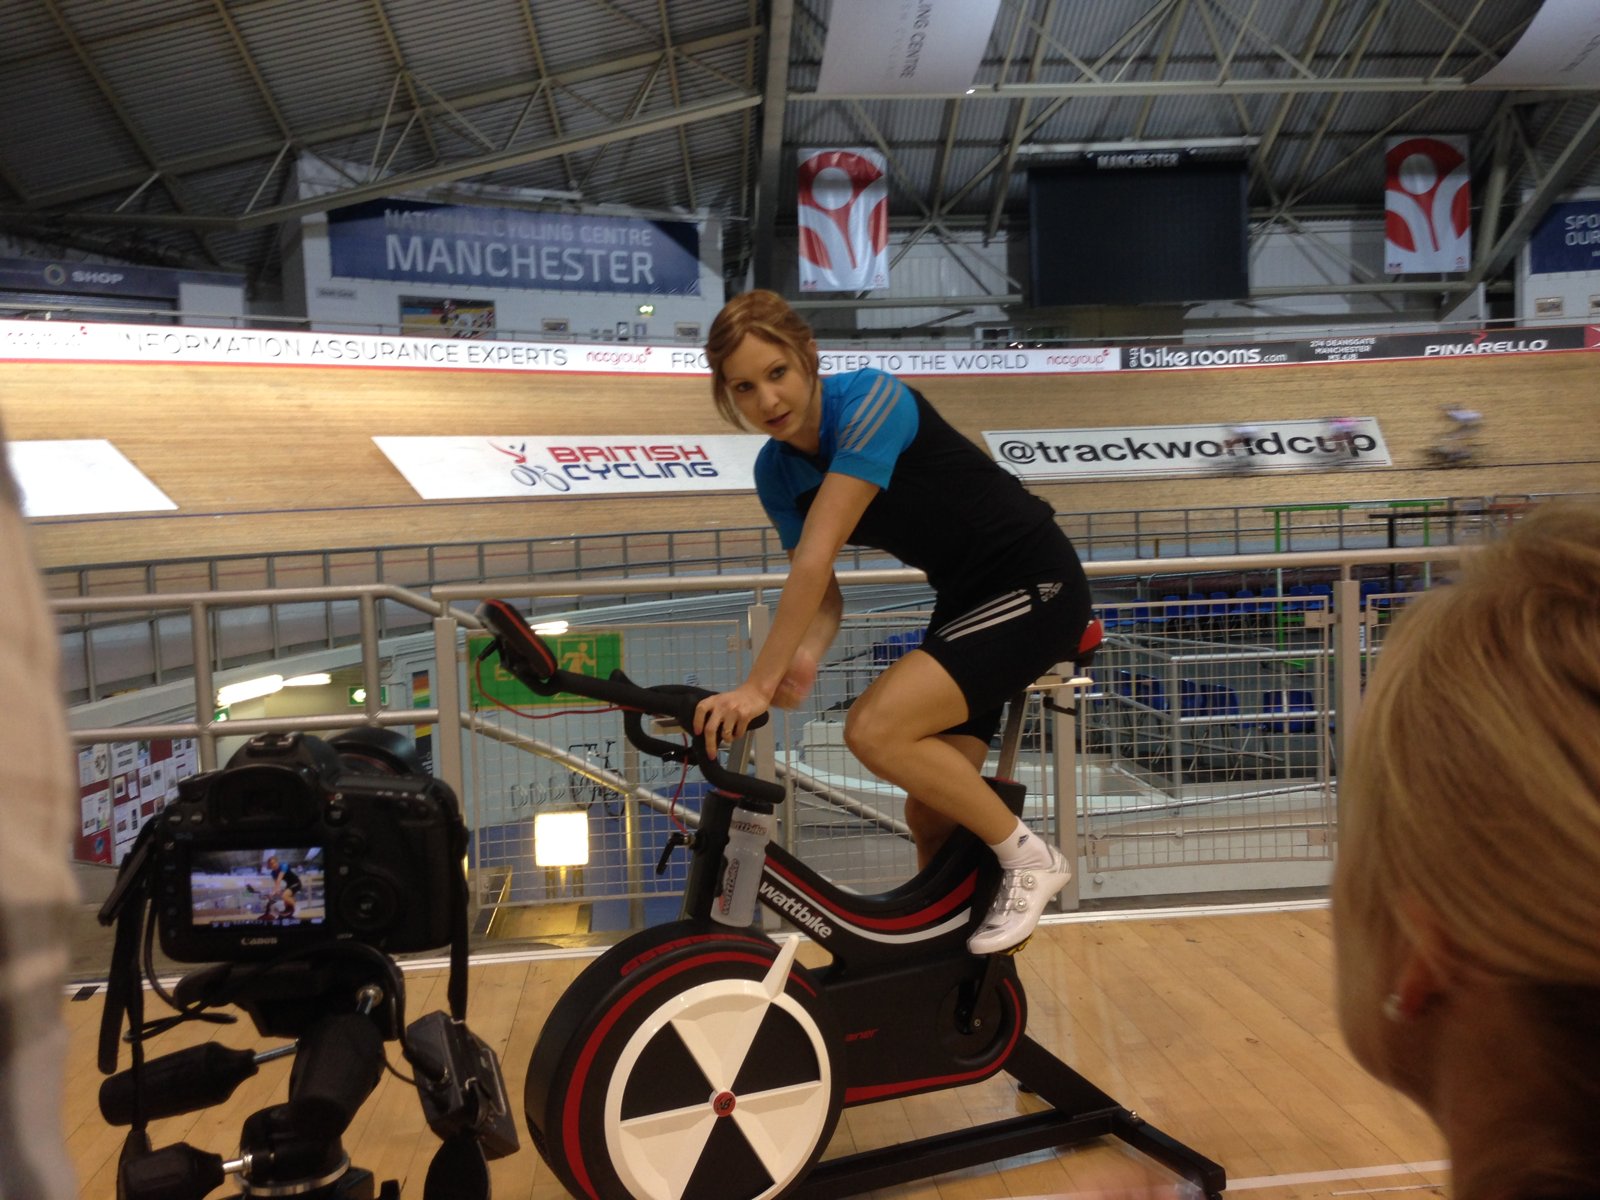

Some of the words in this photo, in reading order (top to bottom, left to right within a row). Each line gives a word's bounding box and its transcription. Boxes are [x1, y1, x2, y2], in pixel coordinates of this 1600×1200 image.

[913, 0, 933, 29] ING
[900, 32, 927, 79] CENTRE
[1097, 153, 1180, 170] MANCHESTER
[1564, 213, 1600, 230] SPO
[492, 219, 574, 242] CYCLING
[578, 225, 654, 247] CENTRE
[385, 233, 656, 285] MANCHESTER
[71, 270, 124, 285] SHOP
[121, 332, 300, 358] NFORMATION
[310, 338, 460, 364] ASSURANCE
[467, 344, 569, 367] EXPERTS
[1315, 345, 1372, 354] MANCHESTER
[1424, 339, 1549, 356] PINARELLO
[671, 352, 709, 369] FRO
[880, 354, 901, 371] TO
[908, 354, 947, 371] THE
[950, 353, 1029, 370] WORLD
[547, 445, 710, 463] BRITISH
[562, 462, 719, 481] CYCLING
[759, 881, 833, 939] wattbike
